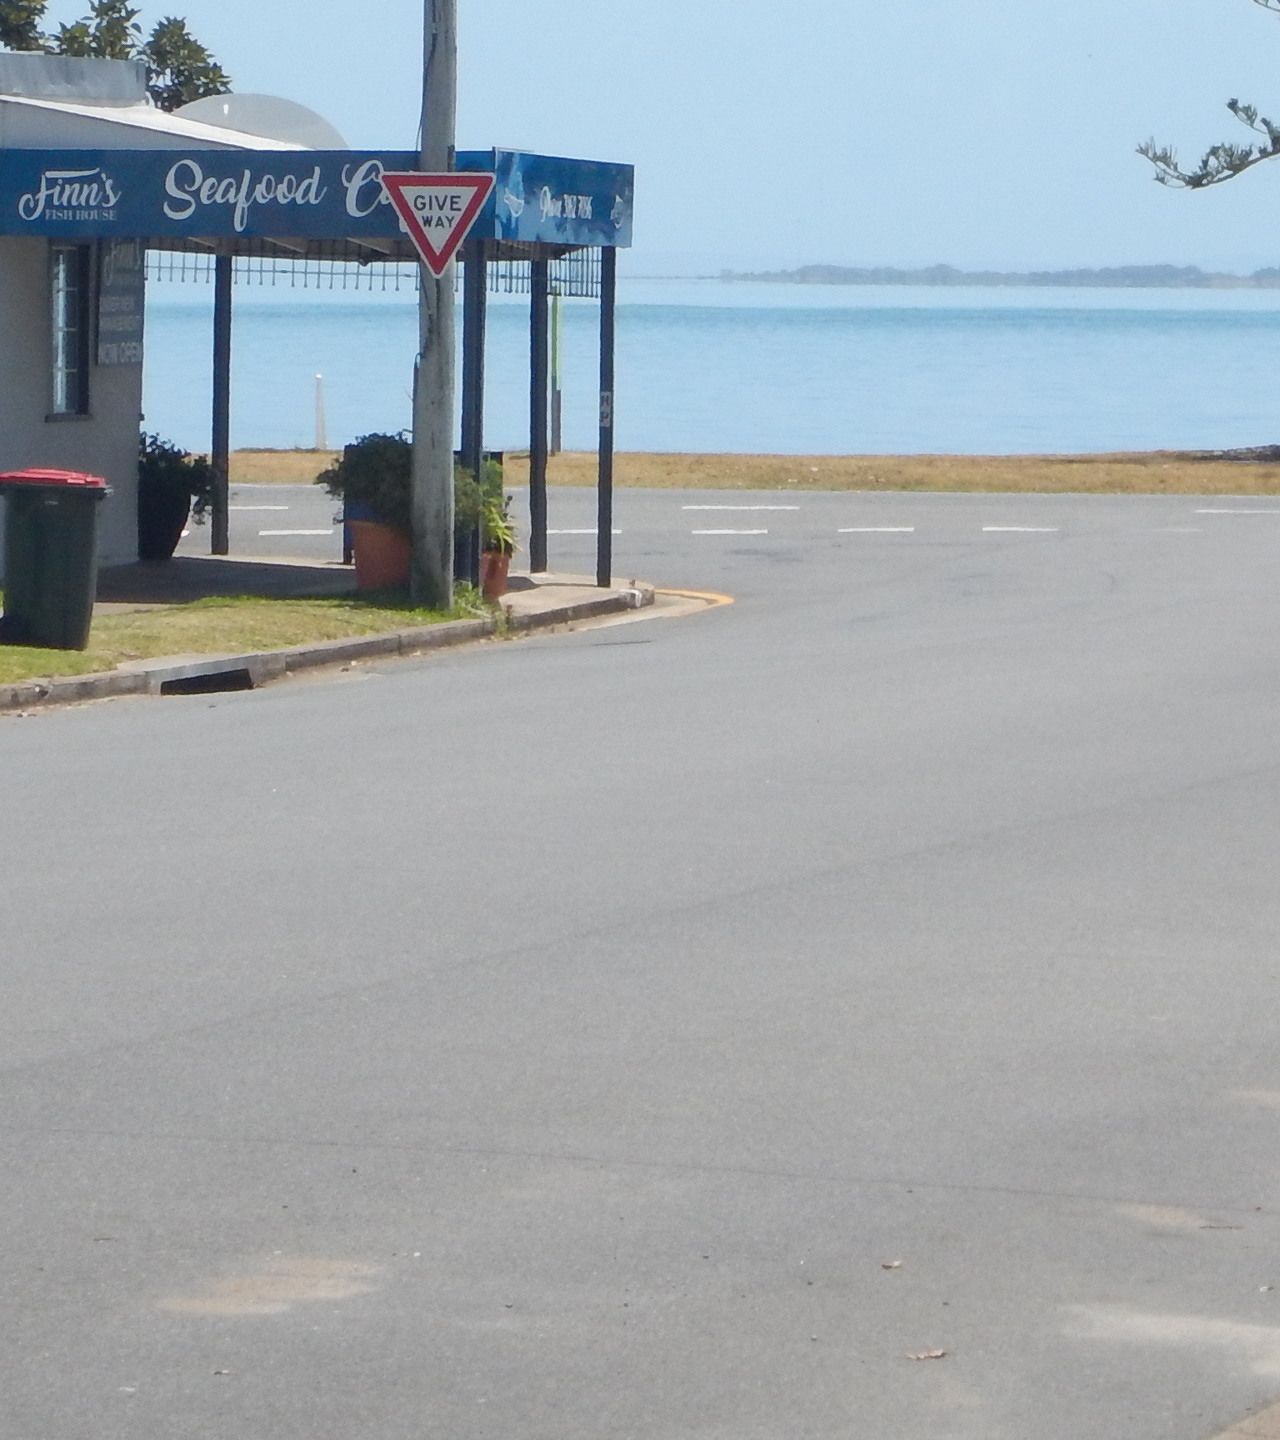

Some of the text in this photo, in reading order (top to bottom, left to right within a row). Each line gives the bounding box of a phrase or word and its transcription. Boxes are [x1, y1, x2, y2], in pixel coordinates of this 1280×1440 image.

[18, 168, 122, 221] Finn's
[163, 159, 328, 232] Seafood
[413, 195, 462, 211] GIVE
[45, 210, 118, 221] FISH HOUSE
[421, 216, 455, 228] WAY
